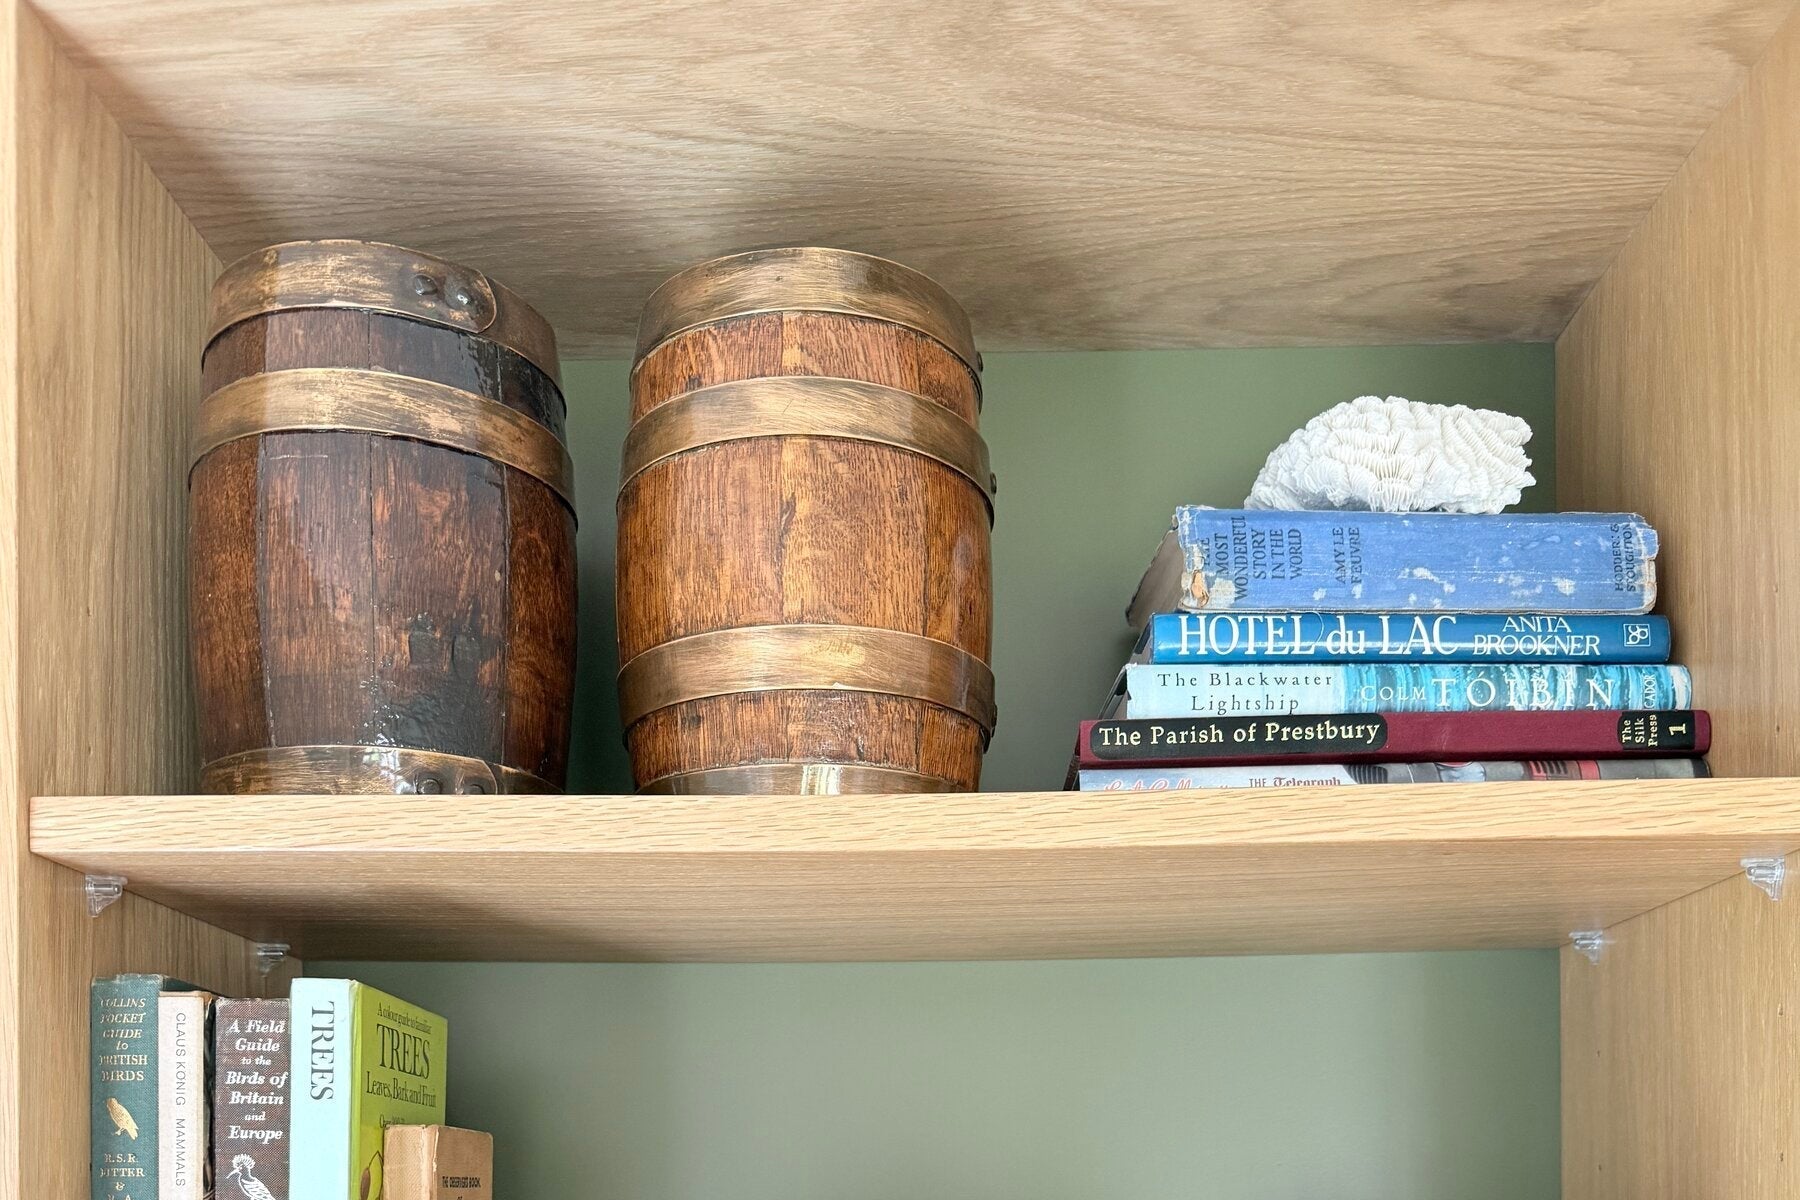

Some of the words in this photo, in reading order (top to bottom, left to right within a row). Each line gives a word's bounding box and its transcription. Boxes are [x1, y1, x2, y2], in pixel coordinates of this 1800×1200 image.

[1270, 528, 1285, 559] THE
[1333, 527, 1344, 547] LE
[1214, 532, 1230, 575] MOST
[1231, 516, 1249, 601] WONDERFUL
[1251, 528, 1267, 580] STORY
[1288, 528, 1303, 580] WORLD
[1349, 527, 1362, 584] FEUVRE
[1271, 561, 1285, 580] IN
[1333, 550, 1346, 584] AMY
[1502, 616, 1572, 633] ANITA
[1178, 615, 1315, 655] HOTEL
[1326, 615, 1366, 655] du
[1379, 615, 1457, 655] LAC
[1472, 634, 1601, 656] BROOKNER
[1157, 673, 1198, 687] The
[1209, 672, 1333, 687] Blackwater
[1191, 695, 1300, 715] Lightship
[1099, 727, 1142, 746] The
[1150, 724, 1225, 745] Parish
[1233, 722, 1257, 742] of
[1265, 722, 1380, 744] Prestbury
[1622, 719, 1632, 743] The
[1635, 717, 1645, 743] Silk
[1648, 714, 1658, 746] Press
[1669, 723, 1687, 735] 1
[100, 998, 146, 1008] COLLINS
[100, 1013, 147, 1023] POCKET
[228, 1020, 241, 1033] A
[245, 1020, 286, 1033] Field
[103, 1029, 142, 1038] GUIDE
[175, 1012, 186, 1057] CLAUS
[116, 1041, 128, 1050] to
[235, 1038, 280, 1052] Guide
[310, 1000, 335, 1101] TREES
[377, 1023, 430, 1079] TREES
[241, 1057, 252, 1066] to
[254, 1055, 272, 1066] the
[101, 1071, 145, 1082] BIRDS
[225, 1071, 265, 1085] Birds
[269, 1071, 289, 1089] of
[229, 1091, 284, 1105] Britain
[393, 1077, 409, 1102] Bark
[409, 1084, 421, 1104] and
[421, 1085, 437, 1108] Fruit
[244, 1112, 266, 1121] and
[228, 1125, 283, 1145] Europe
[175, 1118, 186, 1187] MAMMALS
[115, 1182, 126, 1191] &
